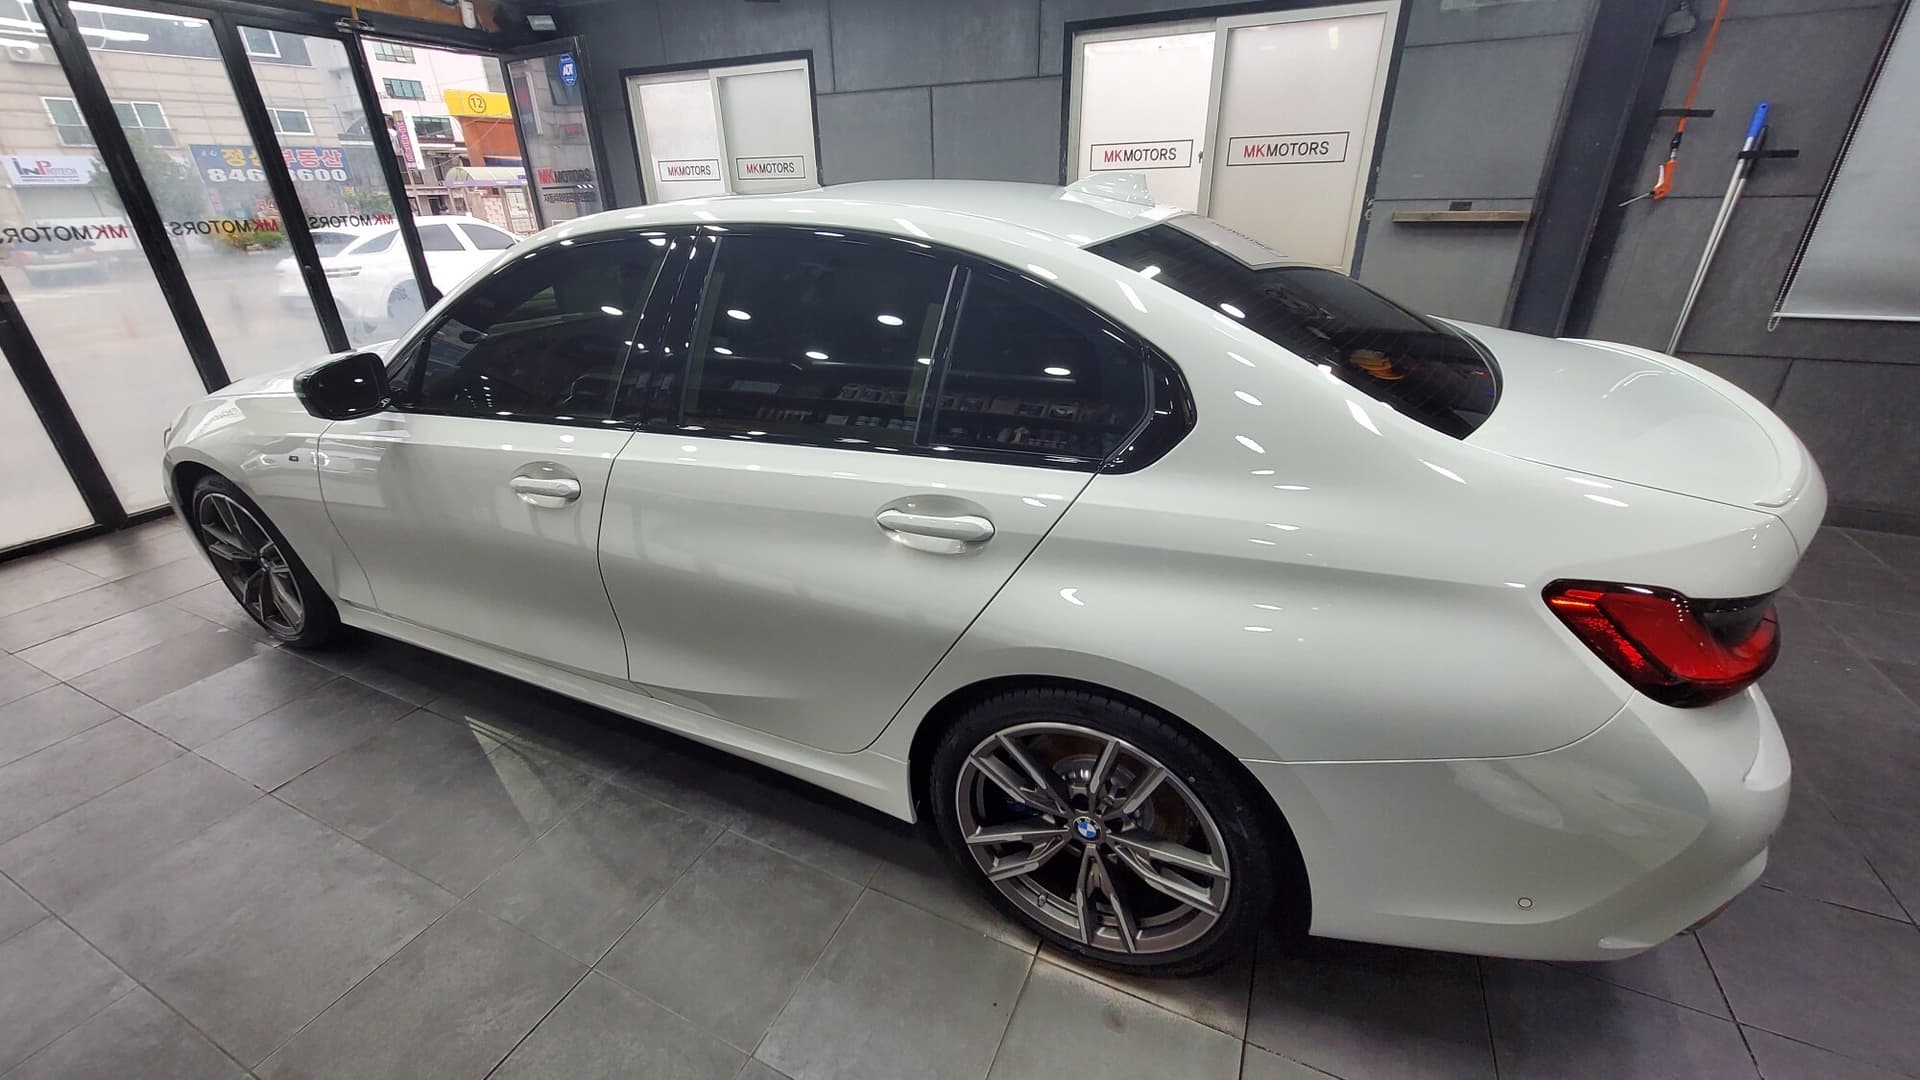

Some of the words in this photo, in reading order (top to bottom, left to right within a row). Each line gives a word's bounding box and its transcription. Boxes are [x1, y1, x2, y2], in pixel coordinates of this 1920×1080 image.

[471, 97, 484, 108] 12
[1103, 147, 1178, 163] MKMOTORS
[1243, 141, 1330, 158] MKMOTORS
[667, 164, 712, 177] MKMOTORS
[746, 162, 795, 174] MKMOTORS
[537, 168, 592, 184] MKMOTORS
